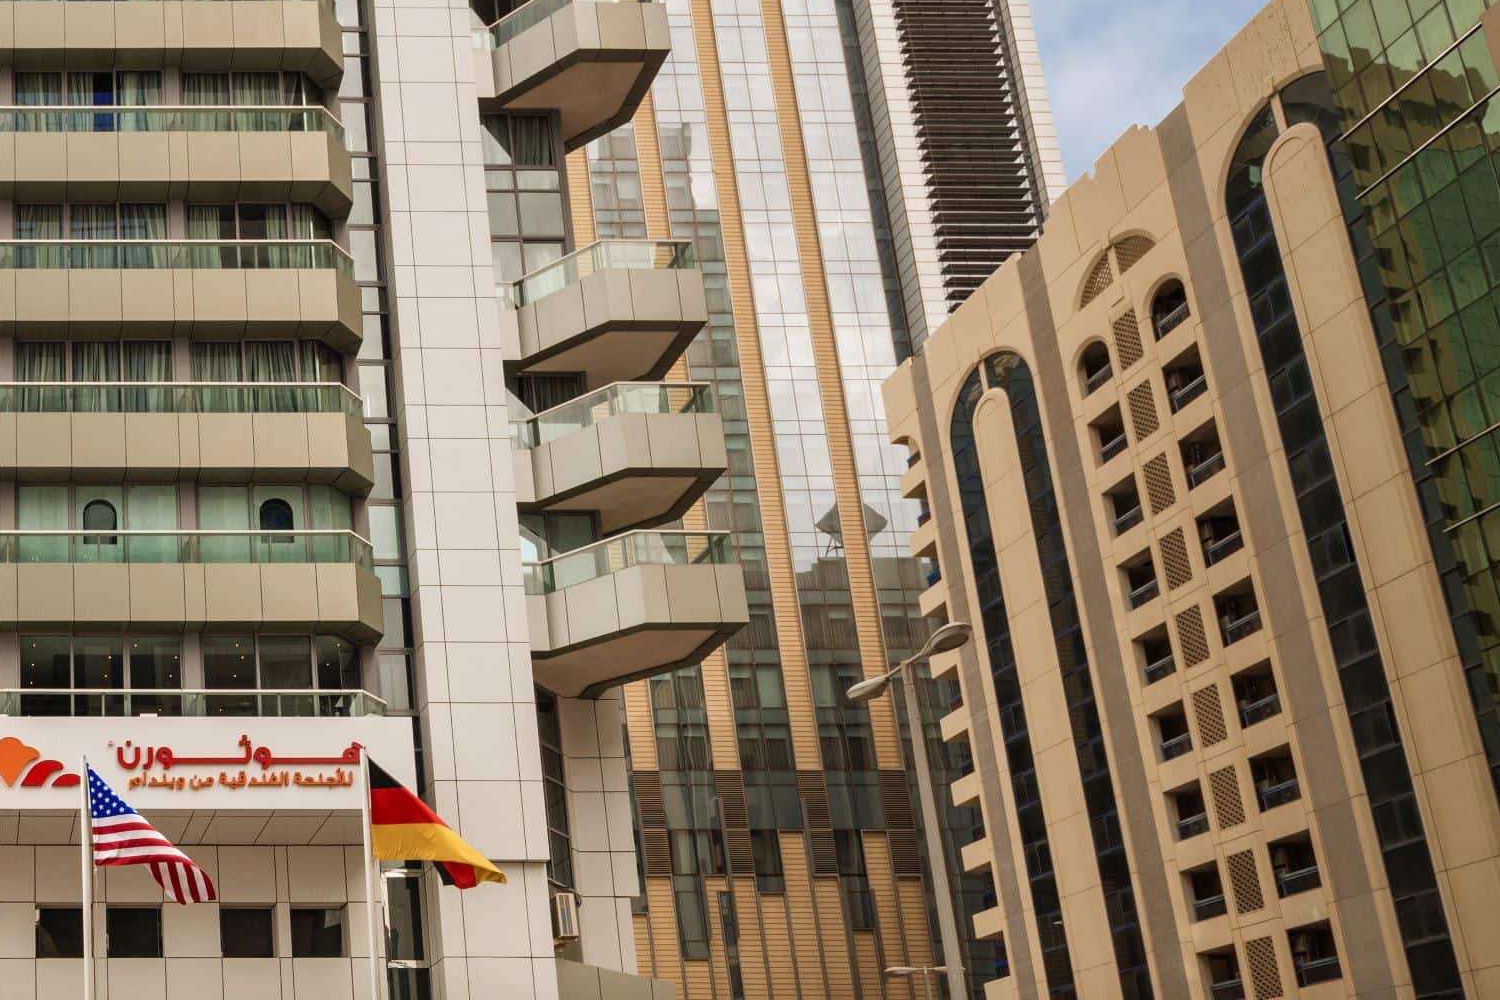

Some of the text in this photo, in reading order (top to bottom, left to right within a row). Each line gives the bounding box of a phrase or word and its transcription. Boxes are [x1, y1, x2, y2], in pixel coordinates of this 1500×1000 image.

[128, 771, 186, 791] ويندام
[189, 774, 215, 791] من
[219, 770, 290, 790] الفندقية
